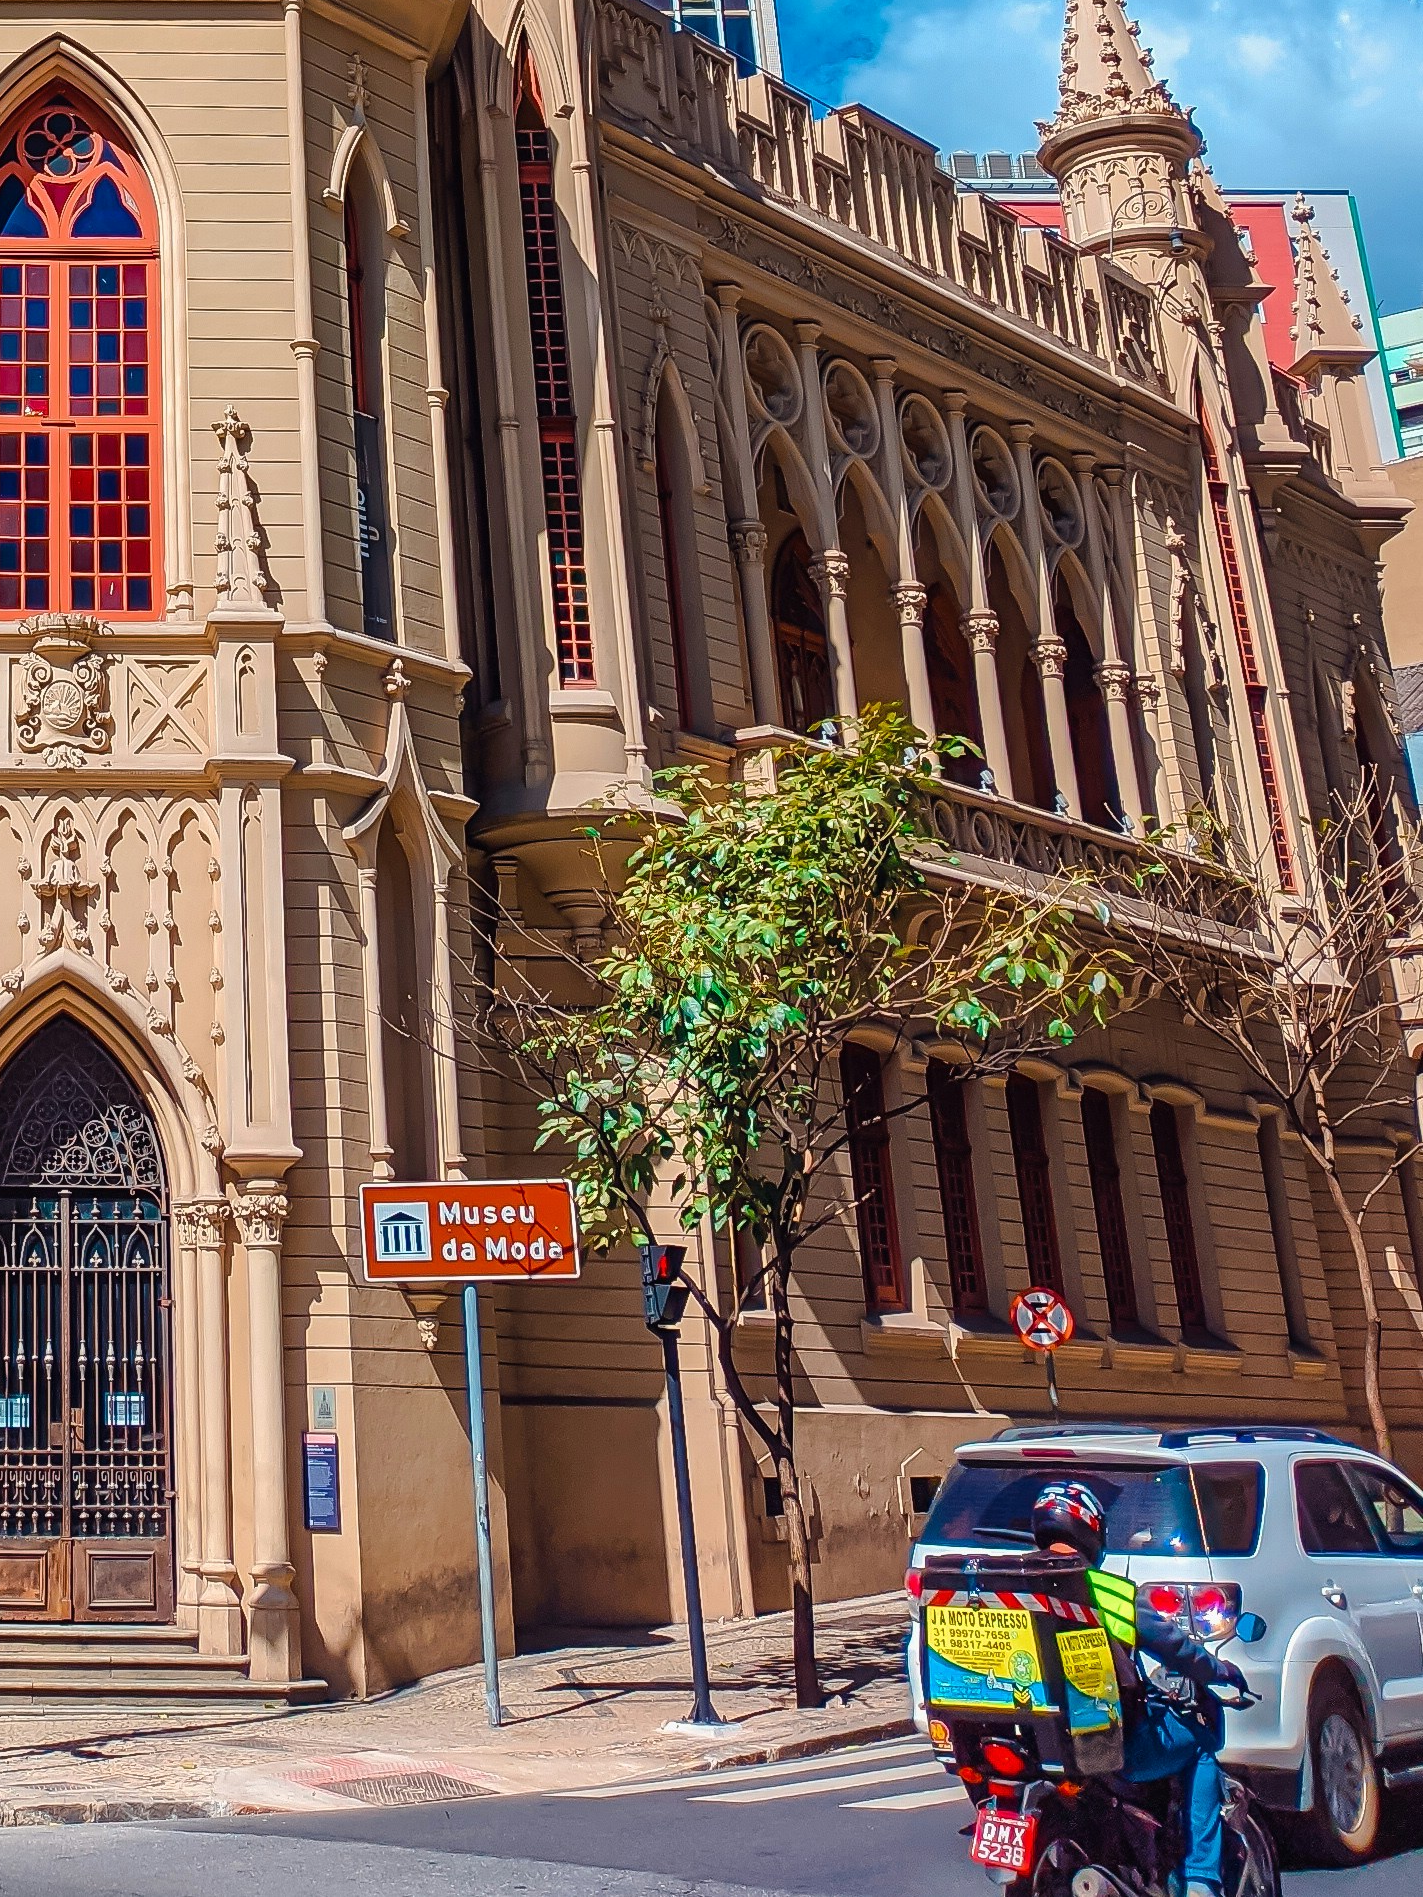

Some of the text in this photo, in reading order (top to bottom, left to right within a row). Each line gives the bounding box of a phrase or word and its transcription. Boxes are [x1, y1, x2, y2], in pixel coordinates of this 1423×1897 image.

[438, 1201, 535, 1225] Museu
[442, 1236, 564, 1261] da Moda
[931, 1609, 1028, 1629] J A MOTO EXPRESSO
[933, 1628, 1011, 1640] 31 99970-7658
[934, 1638, 946, 1647] 31
[983, 1822, 1026, 1847] QMX
[977, 1841, 1026, 1866] 5238
